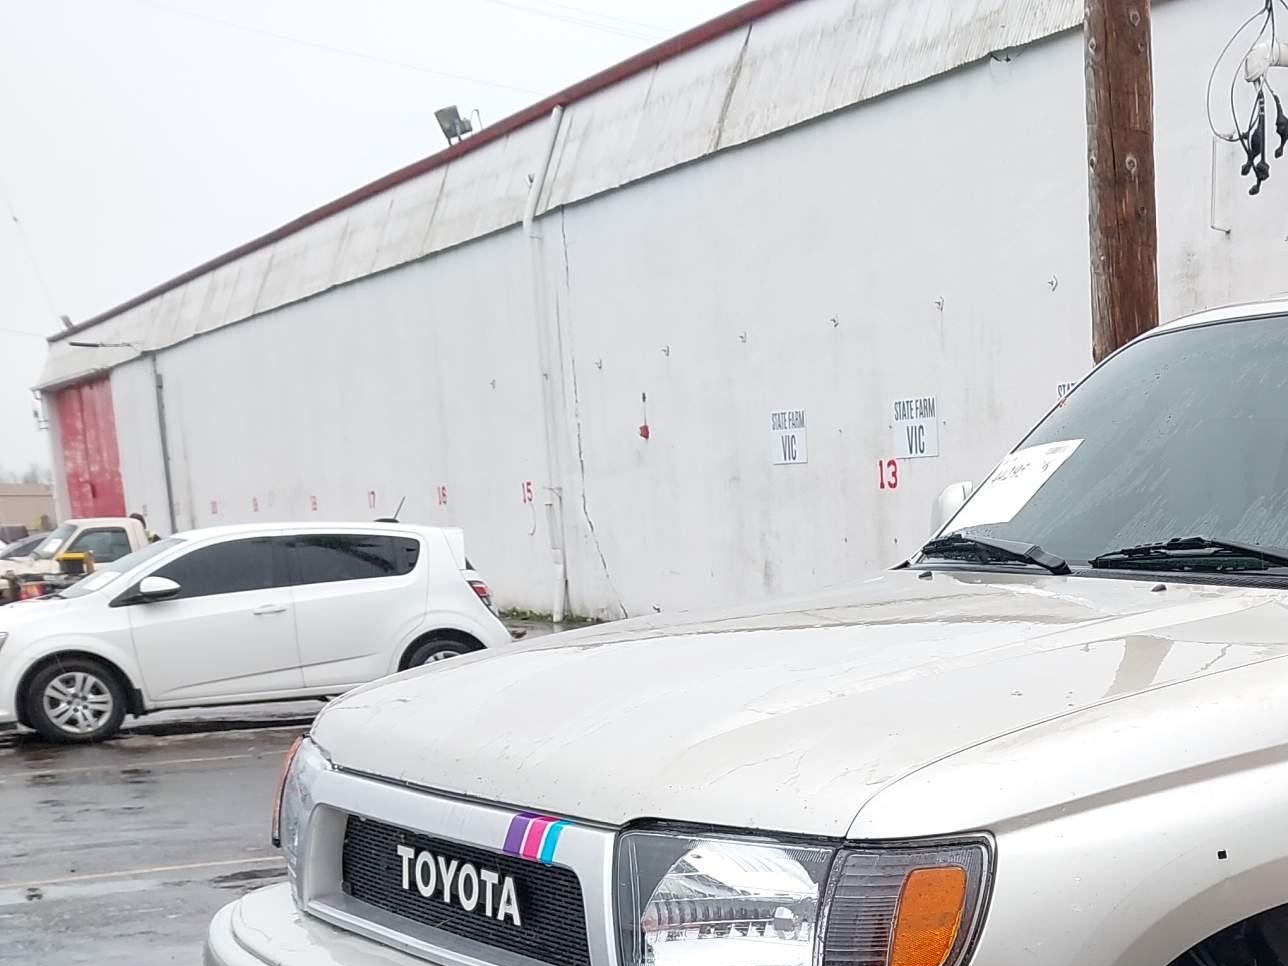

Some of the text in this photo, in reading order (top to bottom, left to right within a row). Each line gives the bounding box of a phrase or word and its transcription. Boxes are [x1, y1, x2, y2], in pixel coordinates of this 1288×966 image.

[772, 410, 805, 431] STATE FARM
[894, 397, 936, 421] STATE FARM
[781, 434, 797, 461] VIC
[906, 425, 925, 455] VIC
[879, 459, 898, 489] 13
[522, 481, 533, 503] 15
[397, 844, 521, 926] TOYOTA
